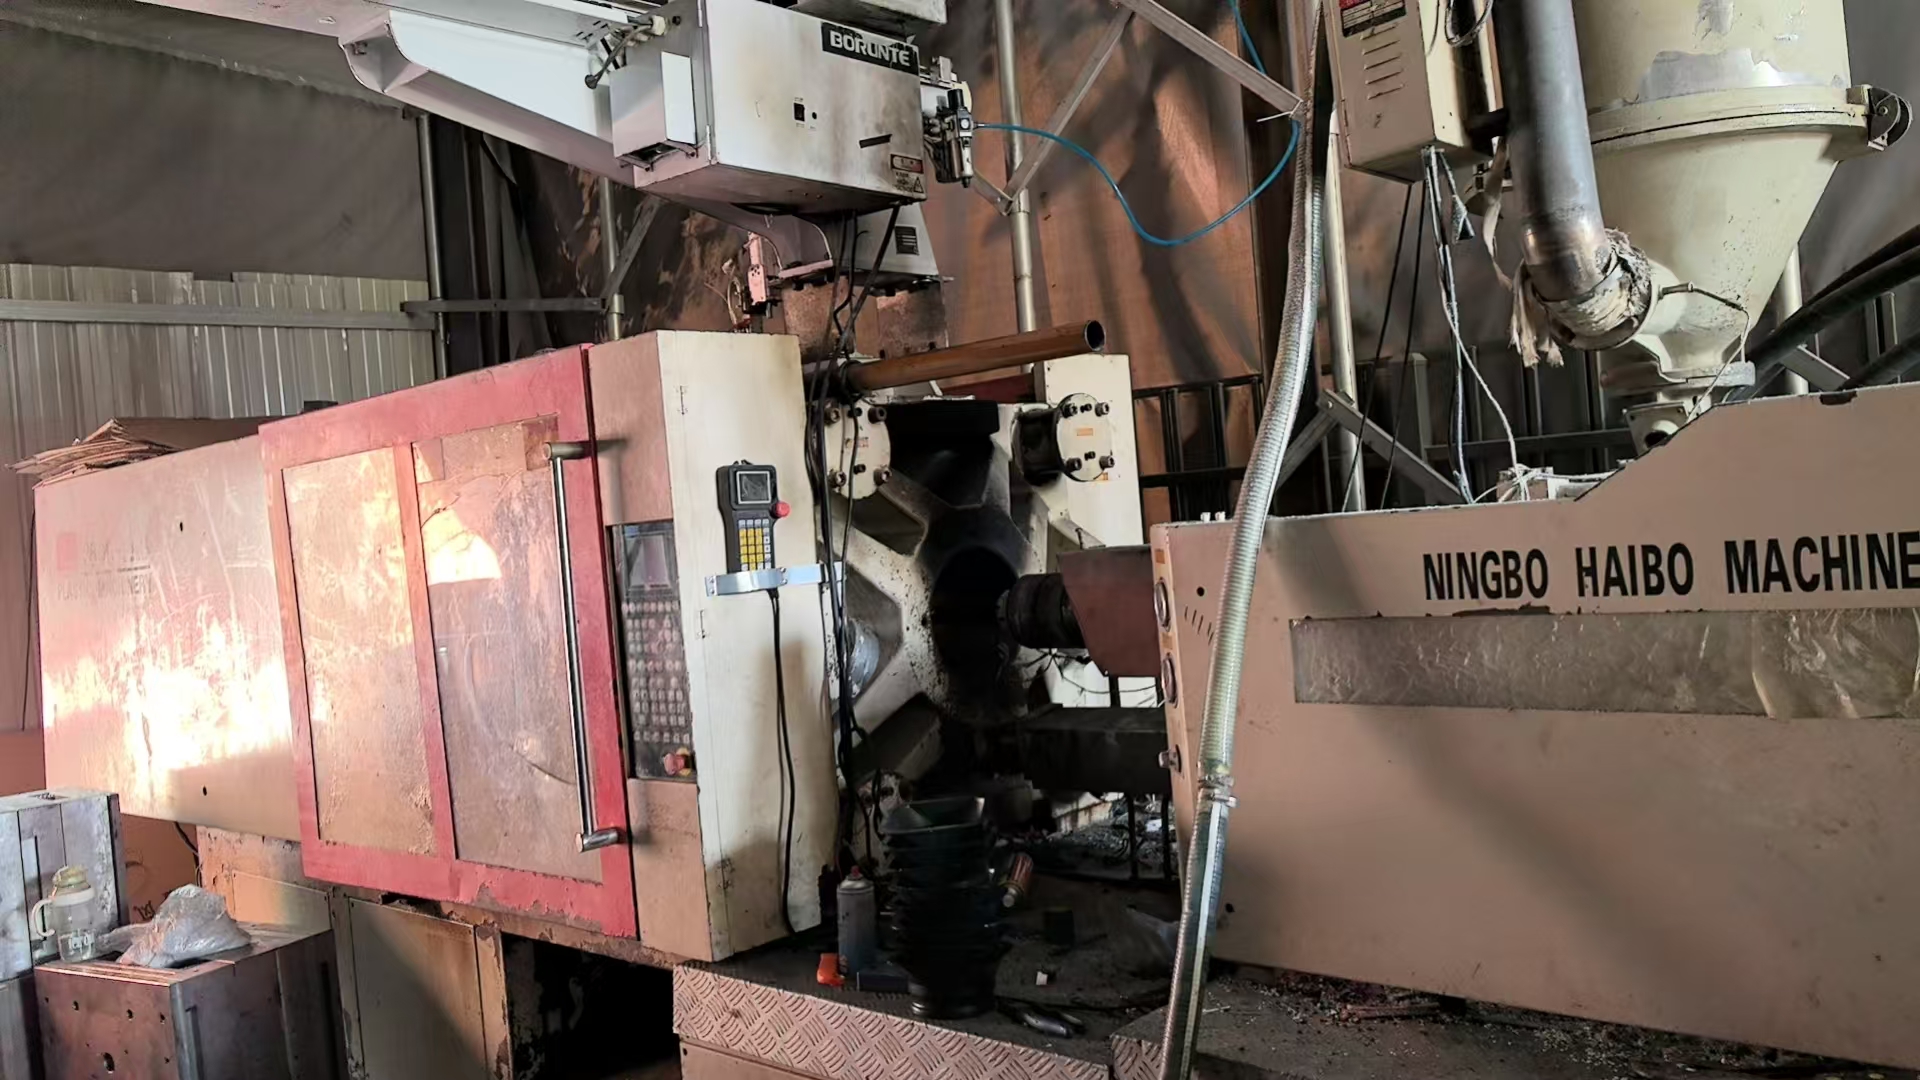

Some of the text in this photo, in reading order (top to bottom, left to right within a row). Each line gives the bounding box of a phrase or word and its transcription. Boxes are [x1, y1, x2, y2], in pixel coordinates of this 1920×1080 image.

[830, 30, 910, 67] BORUNTE
[1423, 530, 1920, 600] NINGBO HAIBO MACHINE
